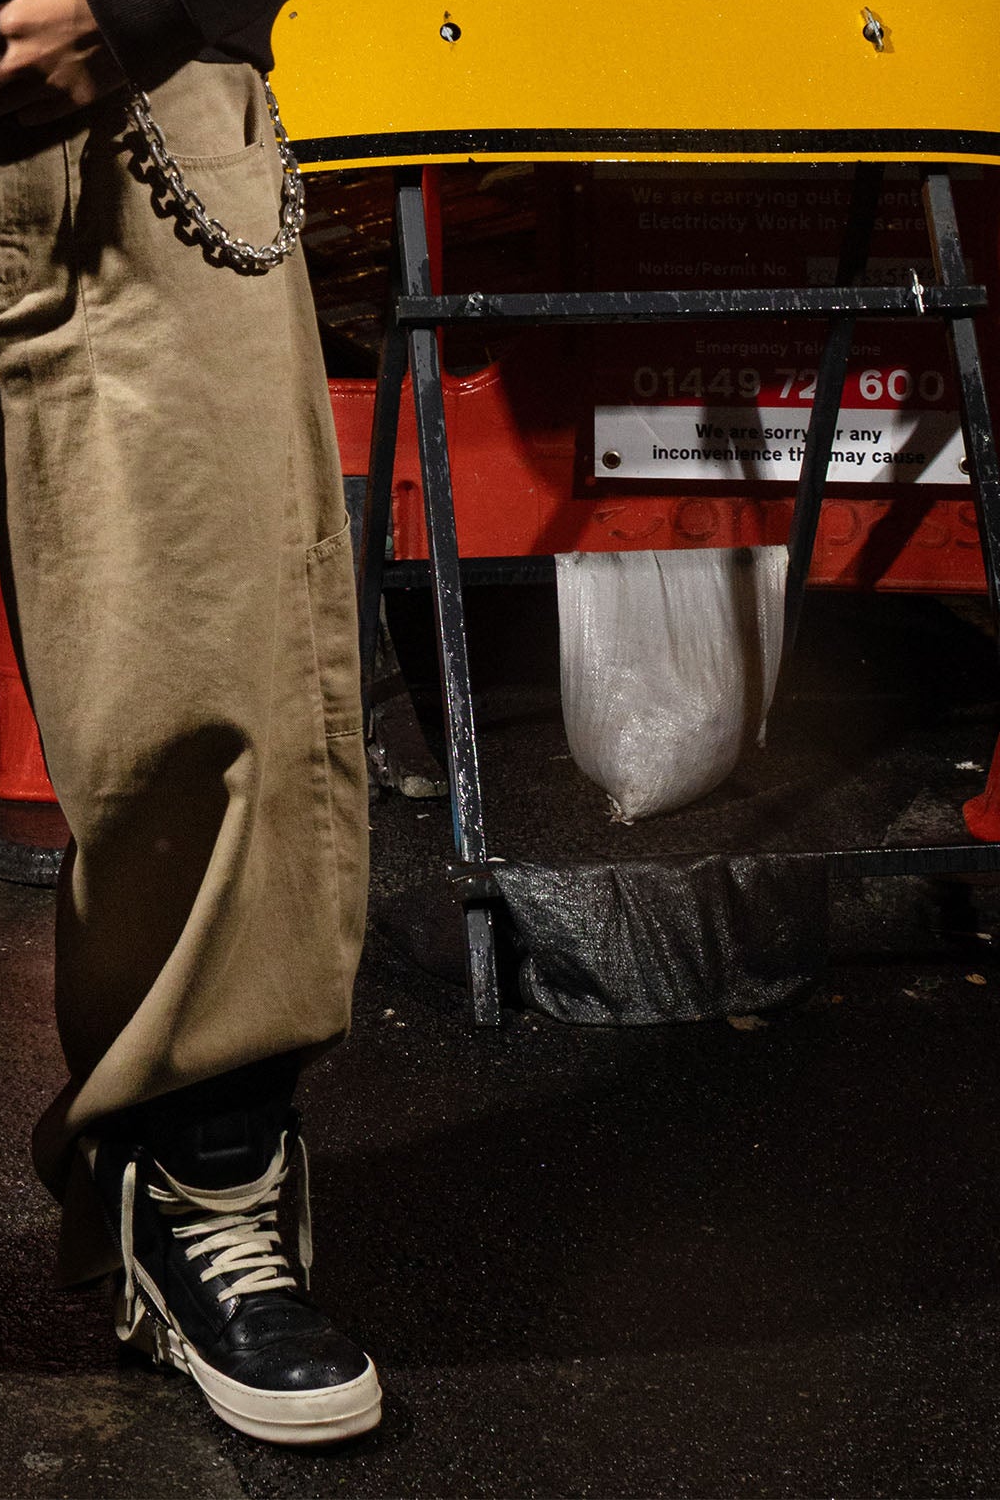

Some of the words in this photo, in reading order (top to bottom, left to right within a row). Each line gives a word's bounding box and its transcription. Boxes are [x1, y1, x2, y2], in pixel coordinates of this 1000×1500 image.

[632, 365, 761, 398] 01449
[695, 424, 723, 439] We
[729, 427, 759, 439] are
[850, 428, 883, 444] any
[652, 444, 783, 462] inconvenience
[829, 451, 866, 465] may
[871, 451, 926, 465] cause
